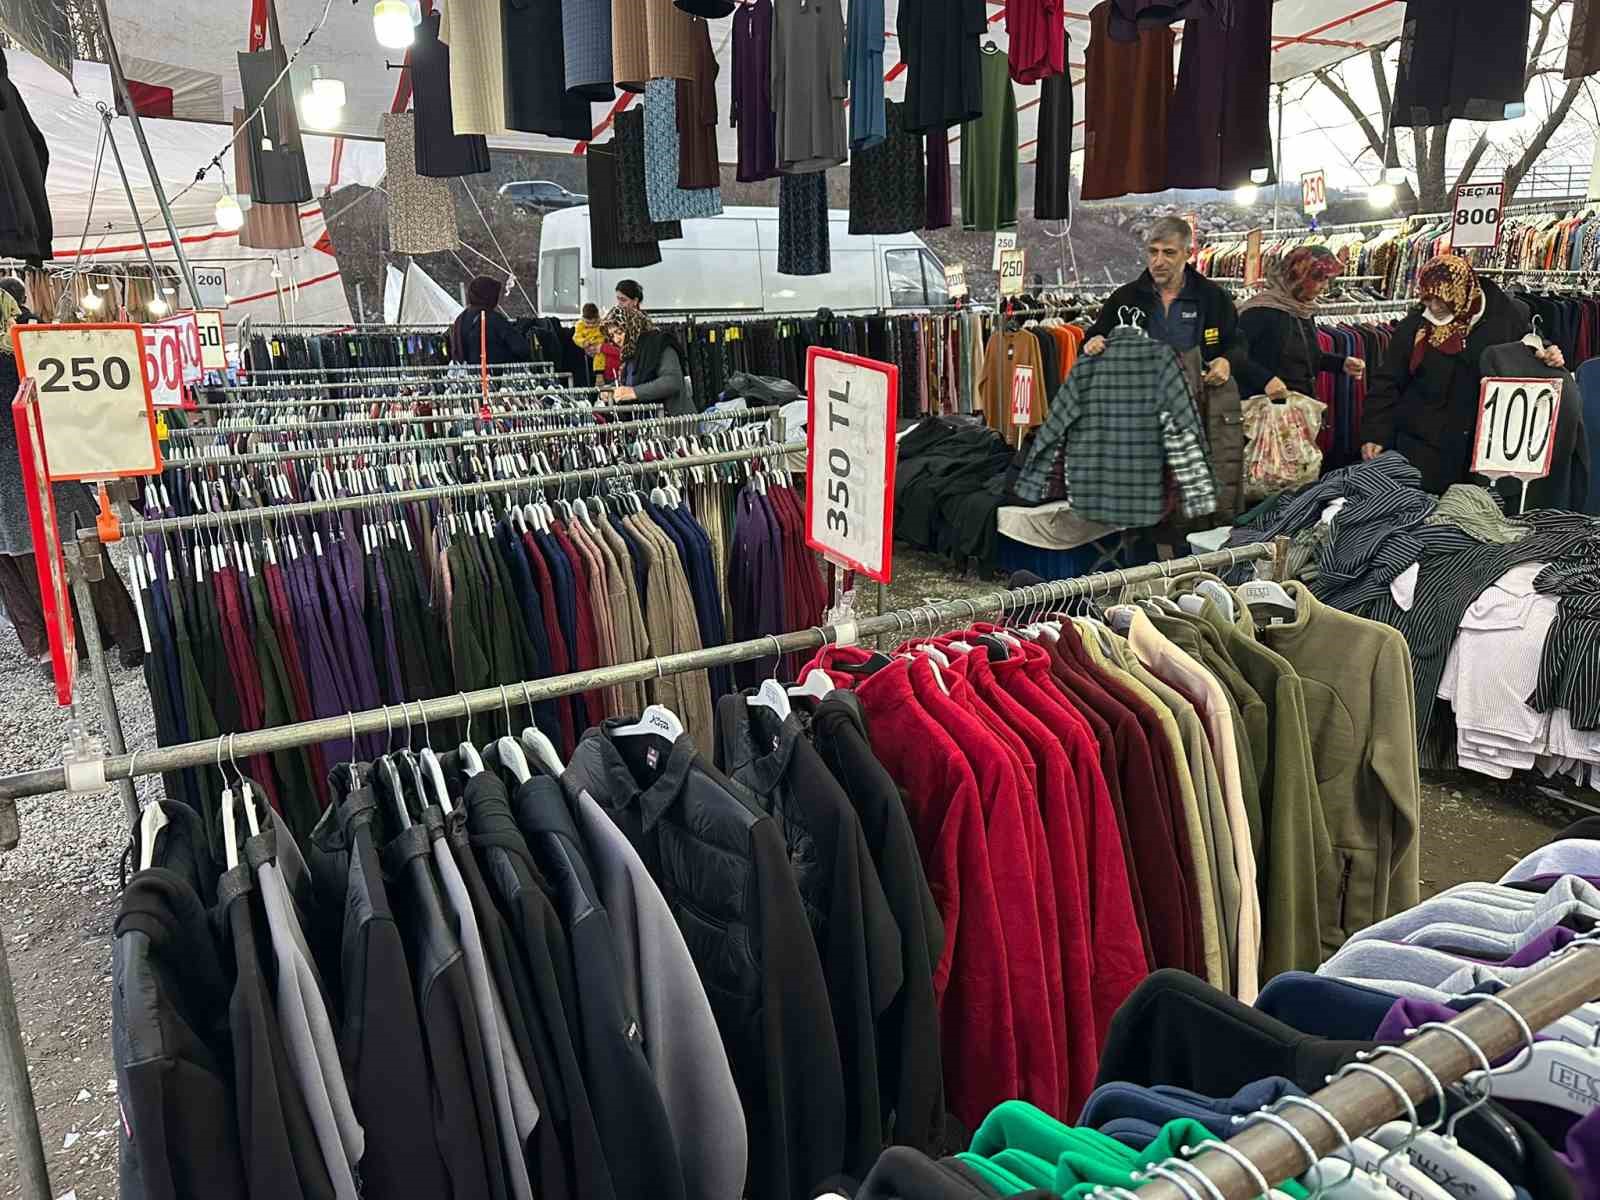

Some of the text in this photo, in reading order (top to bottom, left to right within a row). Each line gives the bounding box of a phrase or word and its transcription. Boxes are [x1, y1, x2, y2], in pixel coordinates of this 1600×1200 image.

[1303, 176, 1325, 205] 250
[1456, 208, 1499, 225] 800
[998, 239, 1013, 247] 250
[198, 275, 221, 285] 200
[1002, 261, 1023, 277] 250
[38, 356, 130, 392] 250
[1484, 386, 1553, 461] 100
[827, 380, 850, 538] 350 TL
